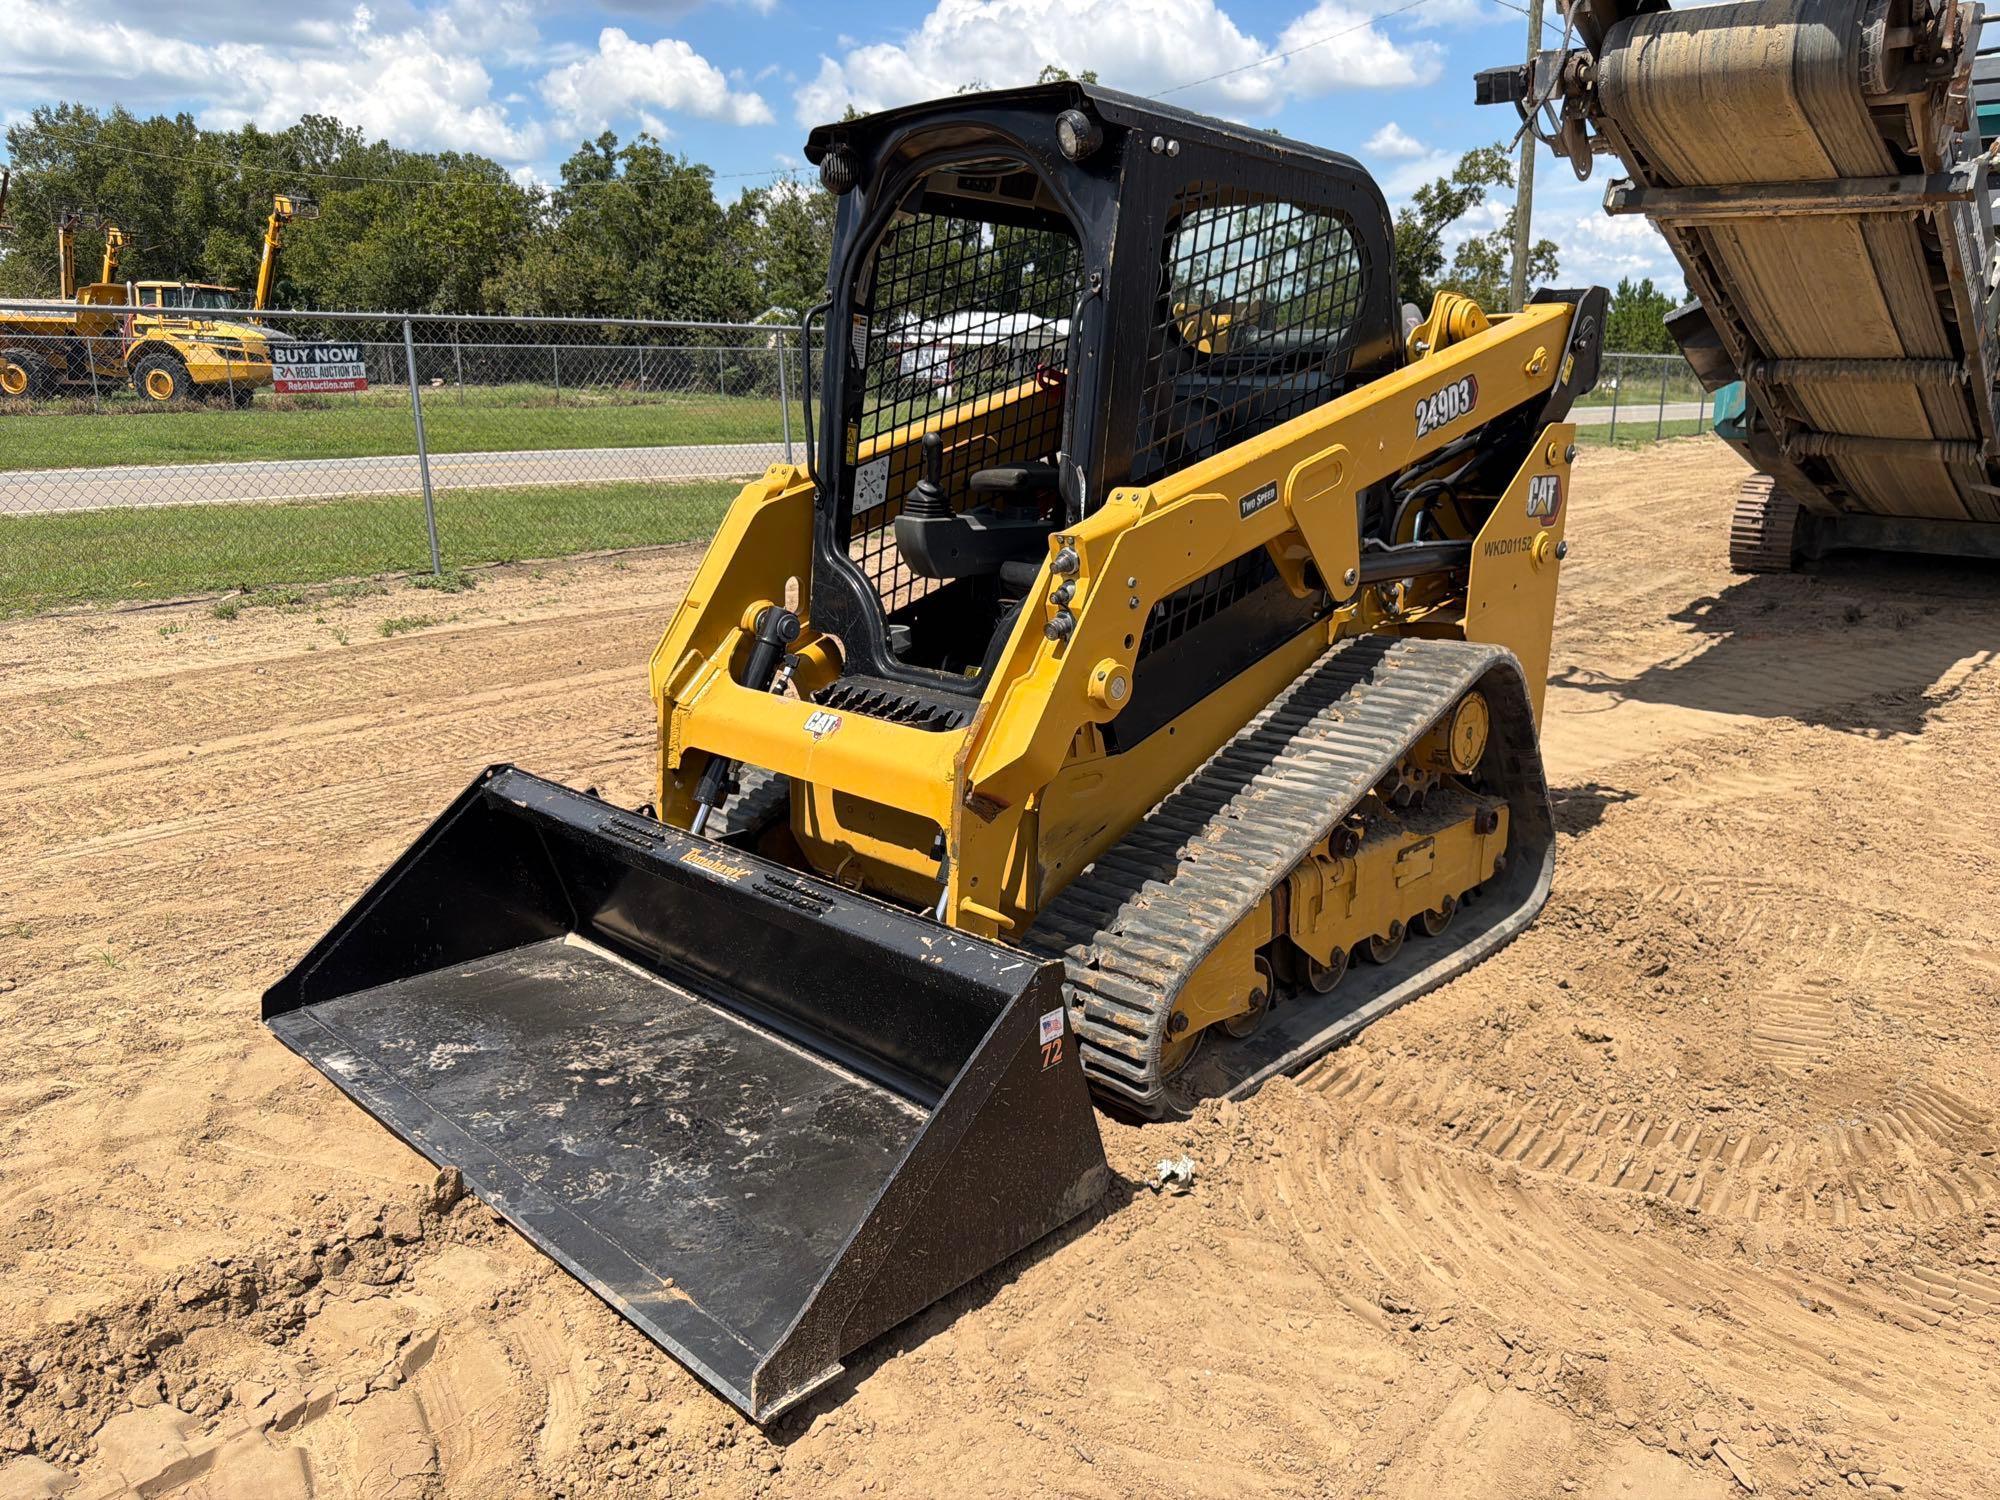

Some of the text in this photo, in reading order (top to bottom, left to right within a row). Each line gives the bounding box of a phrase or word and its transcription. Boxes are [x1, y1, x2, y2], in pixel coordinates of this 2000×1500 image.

[274, 347, 358, 362] BUY NOW
[296, 365, 364, 378] REBEL AUCTION CO.
[288, 381, 355, 391] RebelAuction.com
[1415, 378, 1470, 438] 249D3
[1526, 476, 1557, 516] CAT
[1484, 536, 1532, 557] WKD01152
[803, 710, 839, 734] CAT
[680, 847, 752, 880] Tomahawk
[1040, 1038, 1063, 1069] 72
